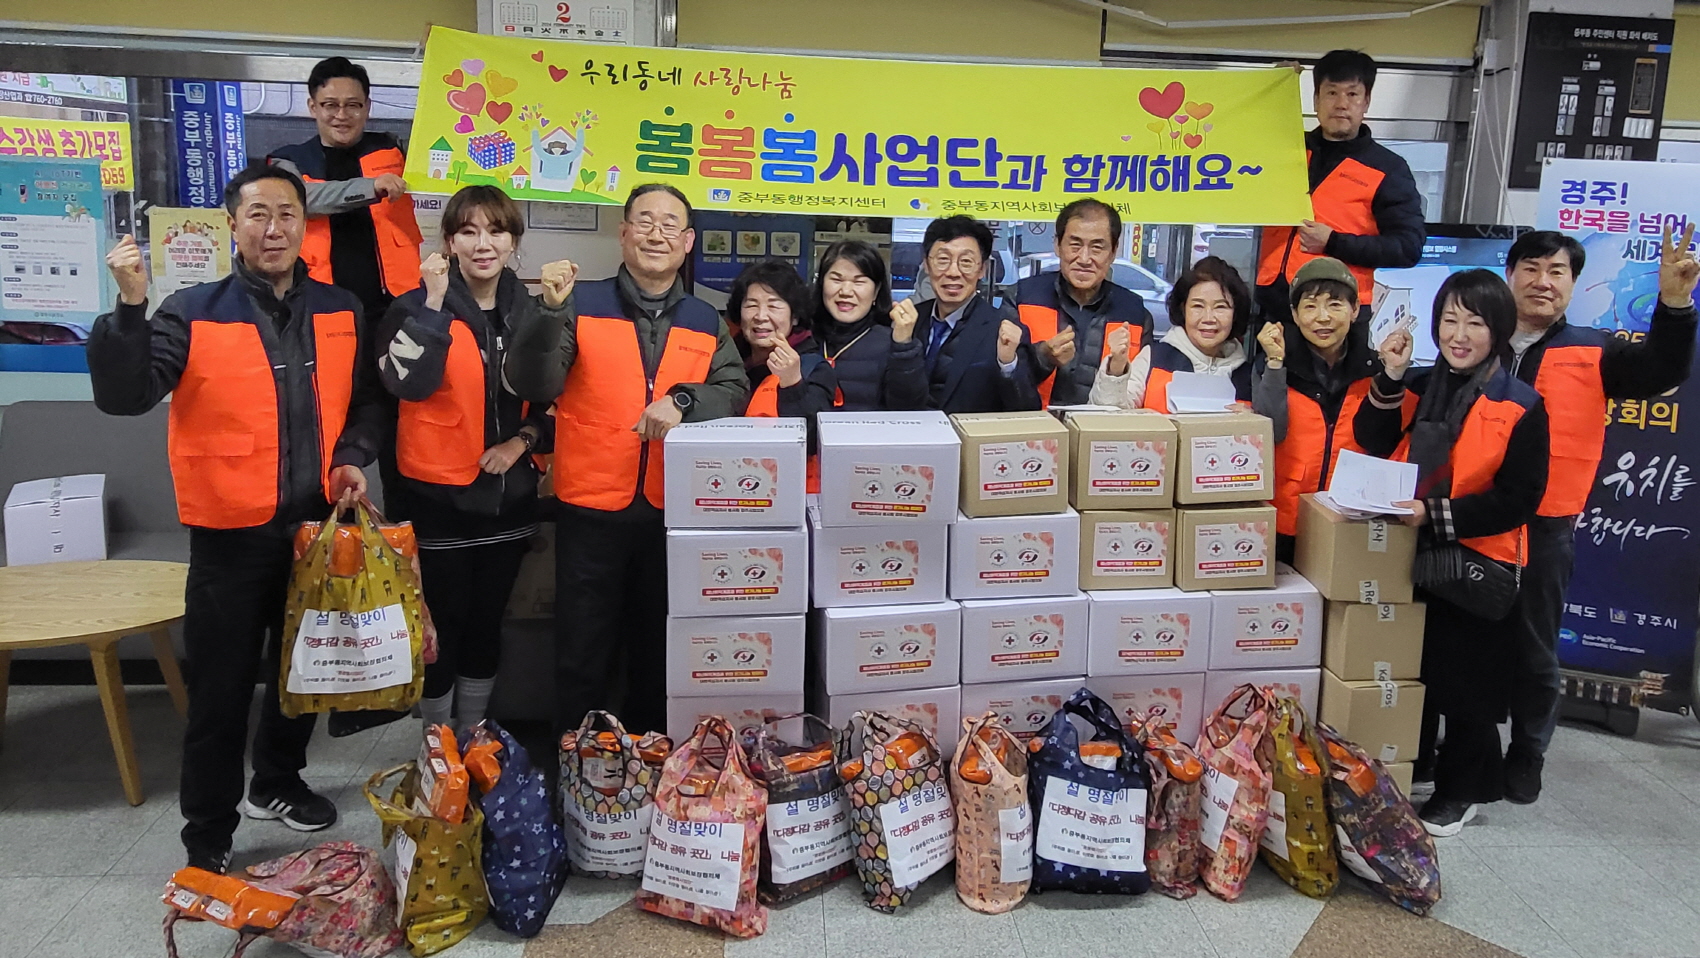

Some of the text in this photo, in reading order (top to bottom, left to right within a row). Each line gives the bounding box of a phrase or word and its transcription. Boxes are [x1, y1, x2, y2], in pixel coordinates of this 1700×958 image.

[556, 3, 571, 23] 2
[580, 59, 797, 100] 우리동네 사랑나눔
[182, 110, 205, 208] 중부동행정
[204, 112, 218, 206] Jungbu Community
[1062, 152, 1262, 193] 함께해요~
[737, 191, 886, 208] 중부동행정복지센터
[1561, 180, 1628, 206] 경주!
[941, 199, 1131, 216] 중부동지역사회보체
[1559, 209, 1687, 236] 한국을 넘어
[1602, 451, 1698, 506] 유치를
[1364, 590, 1375, 603] Re
[316, 611, 329, 626] 설
[1633, 612, 1678, 630] 경주시
[1609, 643, 1645, 655] Cooperation
[1385, 682, 1395, 708] Cros
[1067, 782, 1080, 797] 설
[786, 800, 799, 816] 설
[899, 797, 910, 814] 설
[667, 819, 723, 838] 명절맞이
[720, 850, 740, 862] 나눔
[654, 860, 721, 880] 중부동지역사회보장협의체
